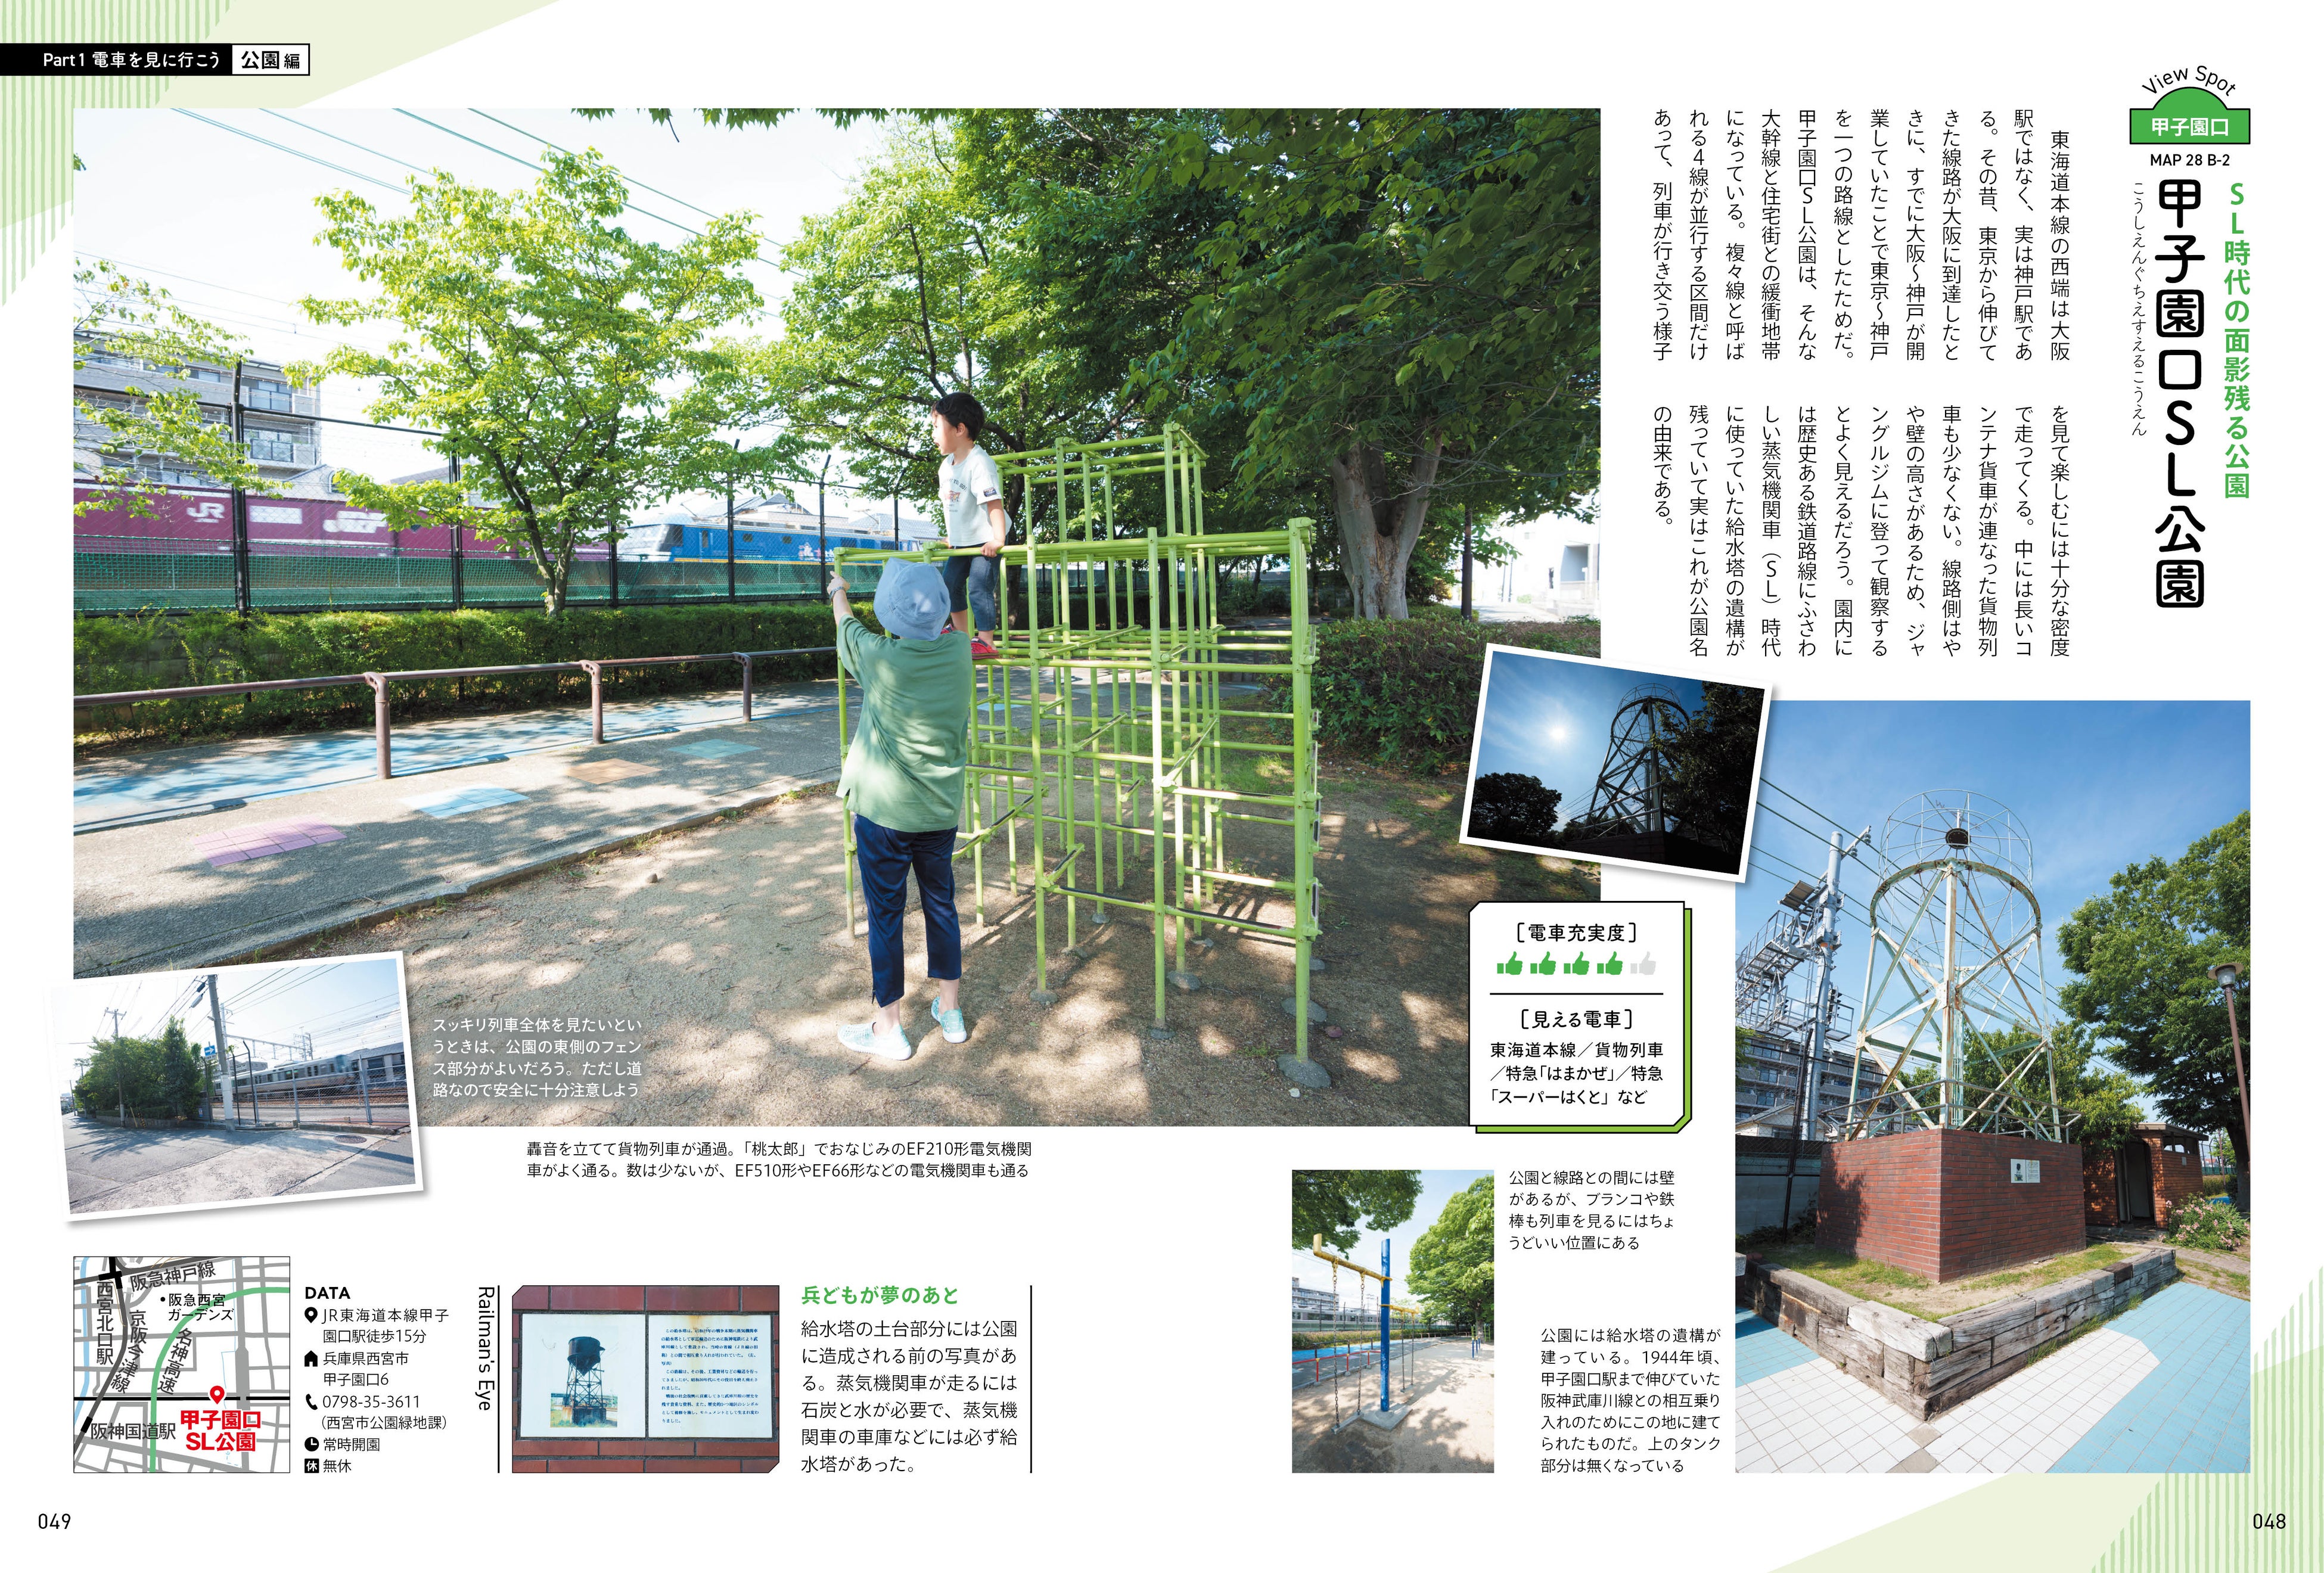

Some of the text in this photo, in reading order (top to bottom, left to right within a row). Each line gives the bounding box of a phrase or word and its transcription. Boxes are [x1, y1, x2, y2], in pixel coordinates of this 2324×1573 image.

[92, 51, 219, 69] 電車を見に行こう
[2142, 65, 2236, 97] View Spot
[2152, 117, 2229, 136] 甲子園口
[2151, 154, 2230, 166] MAP 28 B-2
[1653, 108, 1673, 361] あって、列車が行き交う様子
[1689, 109, 1709, 360] れる4線が並行する区間だけ
[1725, 110, 1745, 360] になっている。複々線と呼ば
[1761, 108, 1781, 360] 大幹線と住宅街との緩衝地帯
[1797, 110, 1817, 360] 甲子園口SL公園は、そんな
[1834, 109, 1853, 358] を一つの路線としたためだ。
[1942, 109, 1962, 360] きた線路が大阪に到達したと
[1978, 111, 1998, 361] る。その昔、東京から伸びて
[2014, 109, 2034, 361] 駅ではなく、実は神戸駅であ
[2050, 130, 2070, 361] 東海道本線の西端は大阪
[2131, 183, 2147, 436] こうしえんぐちえすえるこうえん
[2224, 183, 2251, 499] SL時代の面影残る公園
[2154, 179, 2206, 608] 甲子園口SL公園
[1653, 406, 1673, 525] の由来である。
[1689, 405, 1709, 657] 残っていて実はこれが公園名
[1725, 406, 1745, 657] に使っていた給水塔の遺構が
[1761, 405, 1782, 657] しい蒸気機関車（SL）時代
[1797, 406, 1817, 657] は歴史ある鉄道路線にふさわ
[1834, 406, 1853, 656] とよく見えるだろう。園内に
[1870, 407, 1890, 657] ングルジムに登って観察する
[1906, 405, 1925, 657] や壁の高さがあるため、ジャ
[1942, 405, 1962, 657] 車も少なくない。線路側はや
[1978, 407, 1998, 657] ンテナ貨車が連なった貨物列
[2014, 406, 2034, 656] で走ってくる。中には長いコ
[2050, 405, 2070, 657] を見て楽しむには十分な密度
[433, 1017, 641, 1033] スッキリ列車全体を見たいとい
[434, 1039, 641, 1054] うときは、公園の東側のフェン
[433, 1061, 642, 1076] ス部分がよいだろう。ただし道
[433, 1082, 638, 1098] 路なので安全に十分注意しよう
[526, 1141, 1031, 1157] 轟音を立てて貨物列車が通過。「桃太郎」でおなじみのEF210形電気機関
[527, 1162, 1028, 1178] 車がよく通る。数は少ないが、EF510形やEF66形などの電気機関車も通る
[1509, 1170, 1675, 1186] 公園と線路との間には壁
[1509, 1191, 1674, 1207] があるが、ブランコや鉄
[1509, 1213, 1673, 1229] 棒も列車を見るにはちょ
[1509, 1235, 1639, 1251] うどいい位置にある
[130, 1260, 216, 1292] 阪急神戸線
[168, 1293, 225, 1307] 阪急西宮
[305, 1286, 351, 1300] DATA
[801, 1285, 957, 1305] 兵どもが夢のあと
[97, 1281, 114, 1365] 西宮北口駅
[168, 1308, 234, 1321] ガーデンズ
[321, 1308, 449, 1325] JR東海道本線甲子
[323, 1329, 427, 1344] 園口駅徒歩15分
[801, 1320, 1017, 1338] 給水塔の土台部分には公園
[1541, 1328, 1721, 1343] 公園には給水塔の遺構が
[110, 1310, 148, 1394] 京阪今津線
[474, 1287, 495, 1411] Railman's Eye
[803, 1347, 1016, 1364] に造成される前の写真があ
[1540, 1350, 1719, 1365] 建っている。1944年頃、
[157, 1328, 192, 1395] 名神高速
[323, 1351, 409, 1366] 兵庫県西宮市
[324, 1372, 389, 1387] 甲子園口6
[803, 1374, 1017, 1392] る。蒸気機関車が走るには
[1542, 1371, 1720, 1387] 甲子園口駅まで伸びていた
[322, 1395, 418, 1409] 0798-35-3611
[1541, 1392, 1719, 1409] 阪神武庫川線との相互乗り
[801, 1401, 1018, 1419] 石炭と水が必要で、蒸気機
[181, 1410, 261, 1430] 甲子園口
[1540, 1415, 1720, 1429] 入れのためにこの地に建て
[91, 1423, 176, 1440] 阪神国道駅
[802, 1428, 1018, 1446] 関車の車庫などには必ず給
[186, 1432, 256, 1451] SL公園
[324, 1437, 380, 1452] 常時開園
[1542, 1436, 1720, 1451] られたものだ。上のタンク
[323, 1459, 352, 1473] 無休
[801, 1455, 914, 1473] 水塔があった。
[1540, 1457, 1683, 1473] 部分は無くなっている
[38, 1513, 71, 1530] 049
[2253, 1513, 2286, 1530] 048
